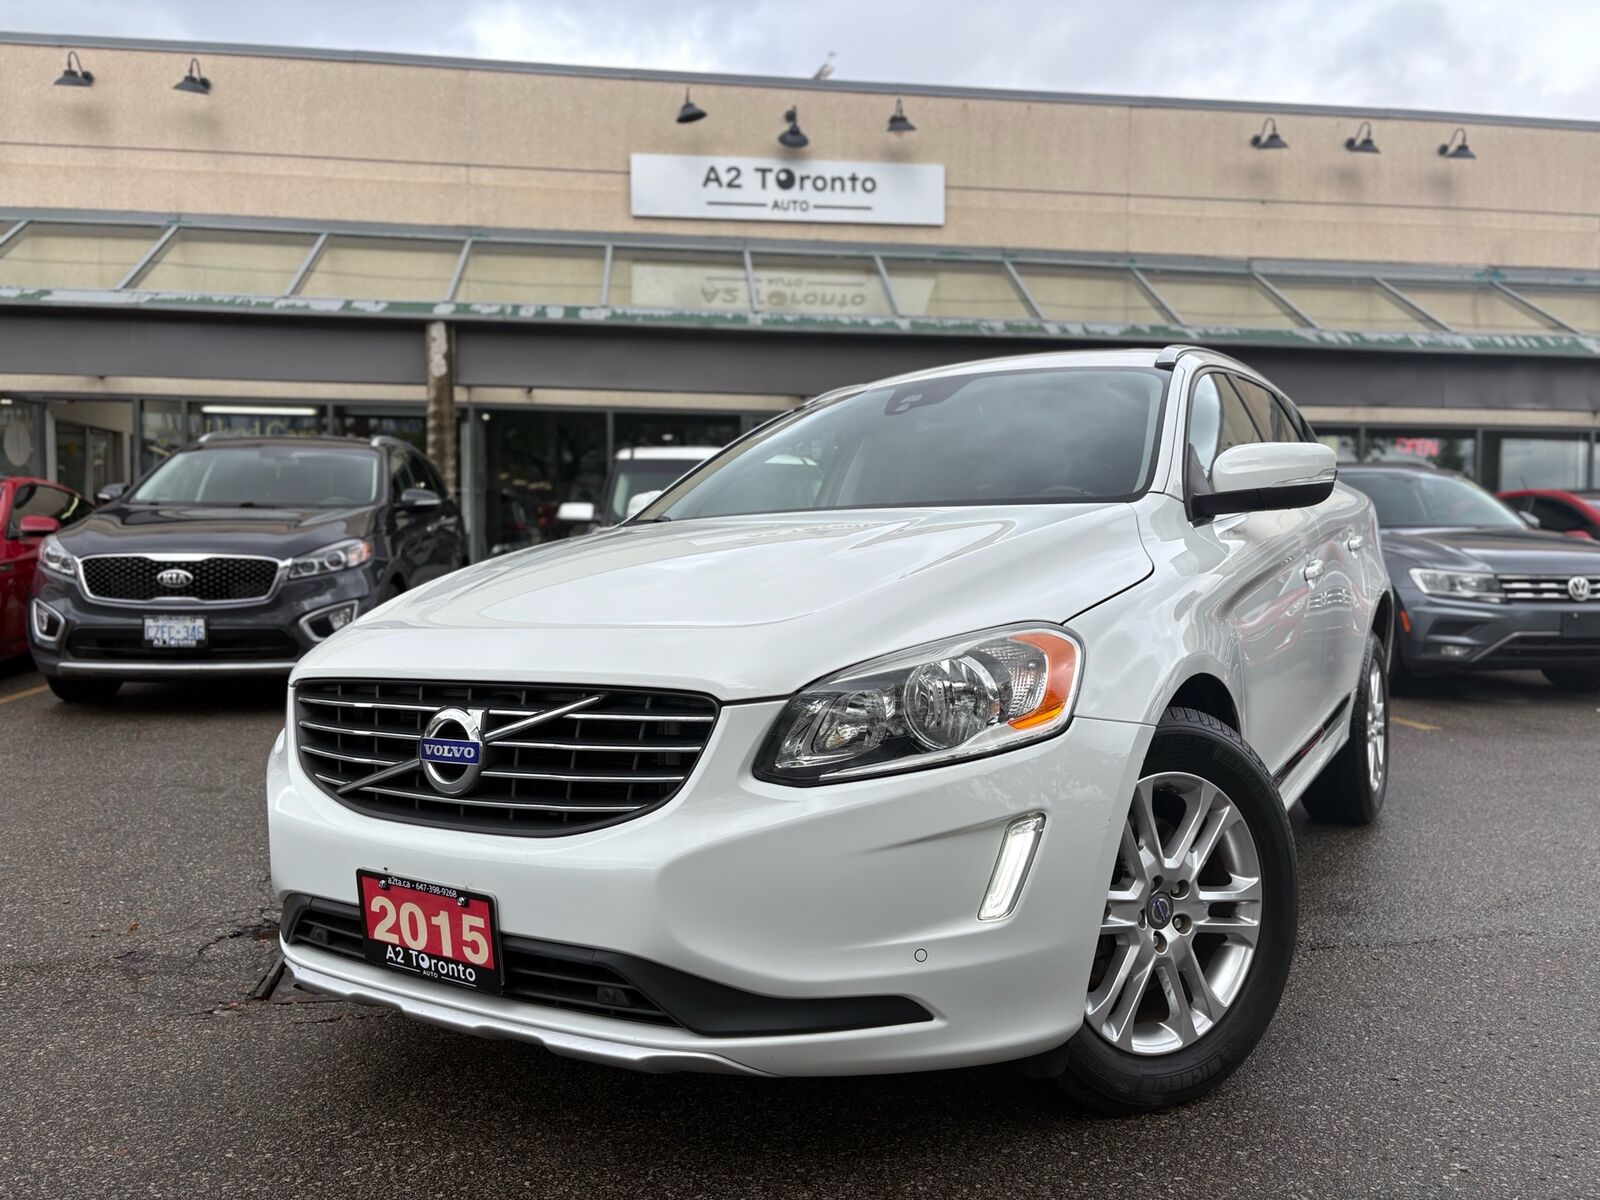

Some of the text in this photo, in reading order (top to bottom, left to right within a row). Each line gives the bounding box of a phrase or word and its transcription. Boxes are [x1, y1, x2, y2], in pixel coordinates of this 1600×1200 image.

[702, 166, 743, 189] A2
[771, 200, 810, 212] AUTO
[162, 573, 188, 584] KIA
[423, 743, 476, 758] VOLVO
[387, 876, 458, 898] a2ta.ca 647-398-9268
[370, 895, 489, 965] 2015
[386, 945, 405, 963] A2
[422, 970, 439, 979] AUTO
